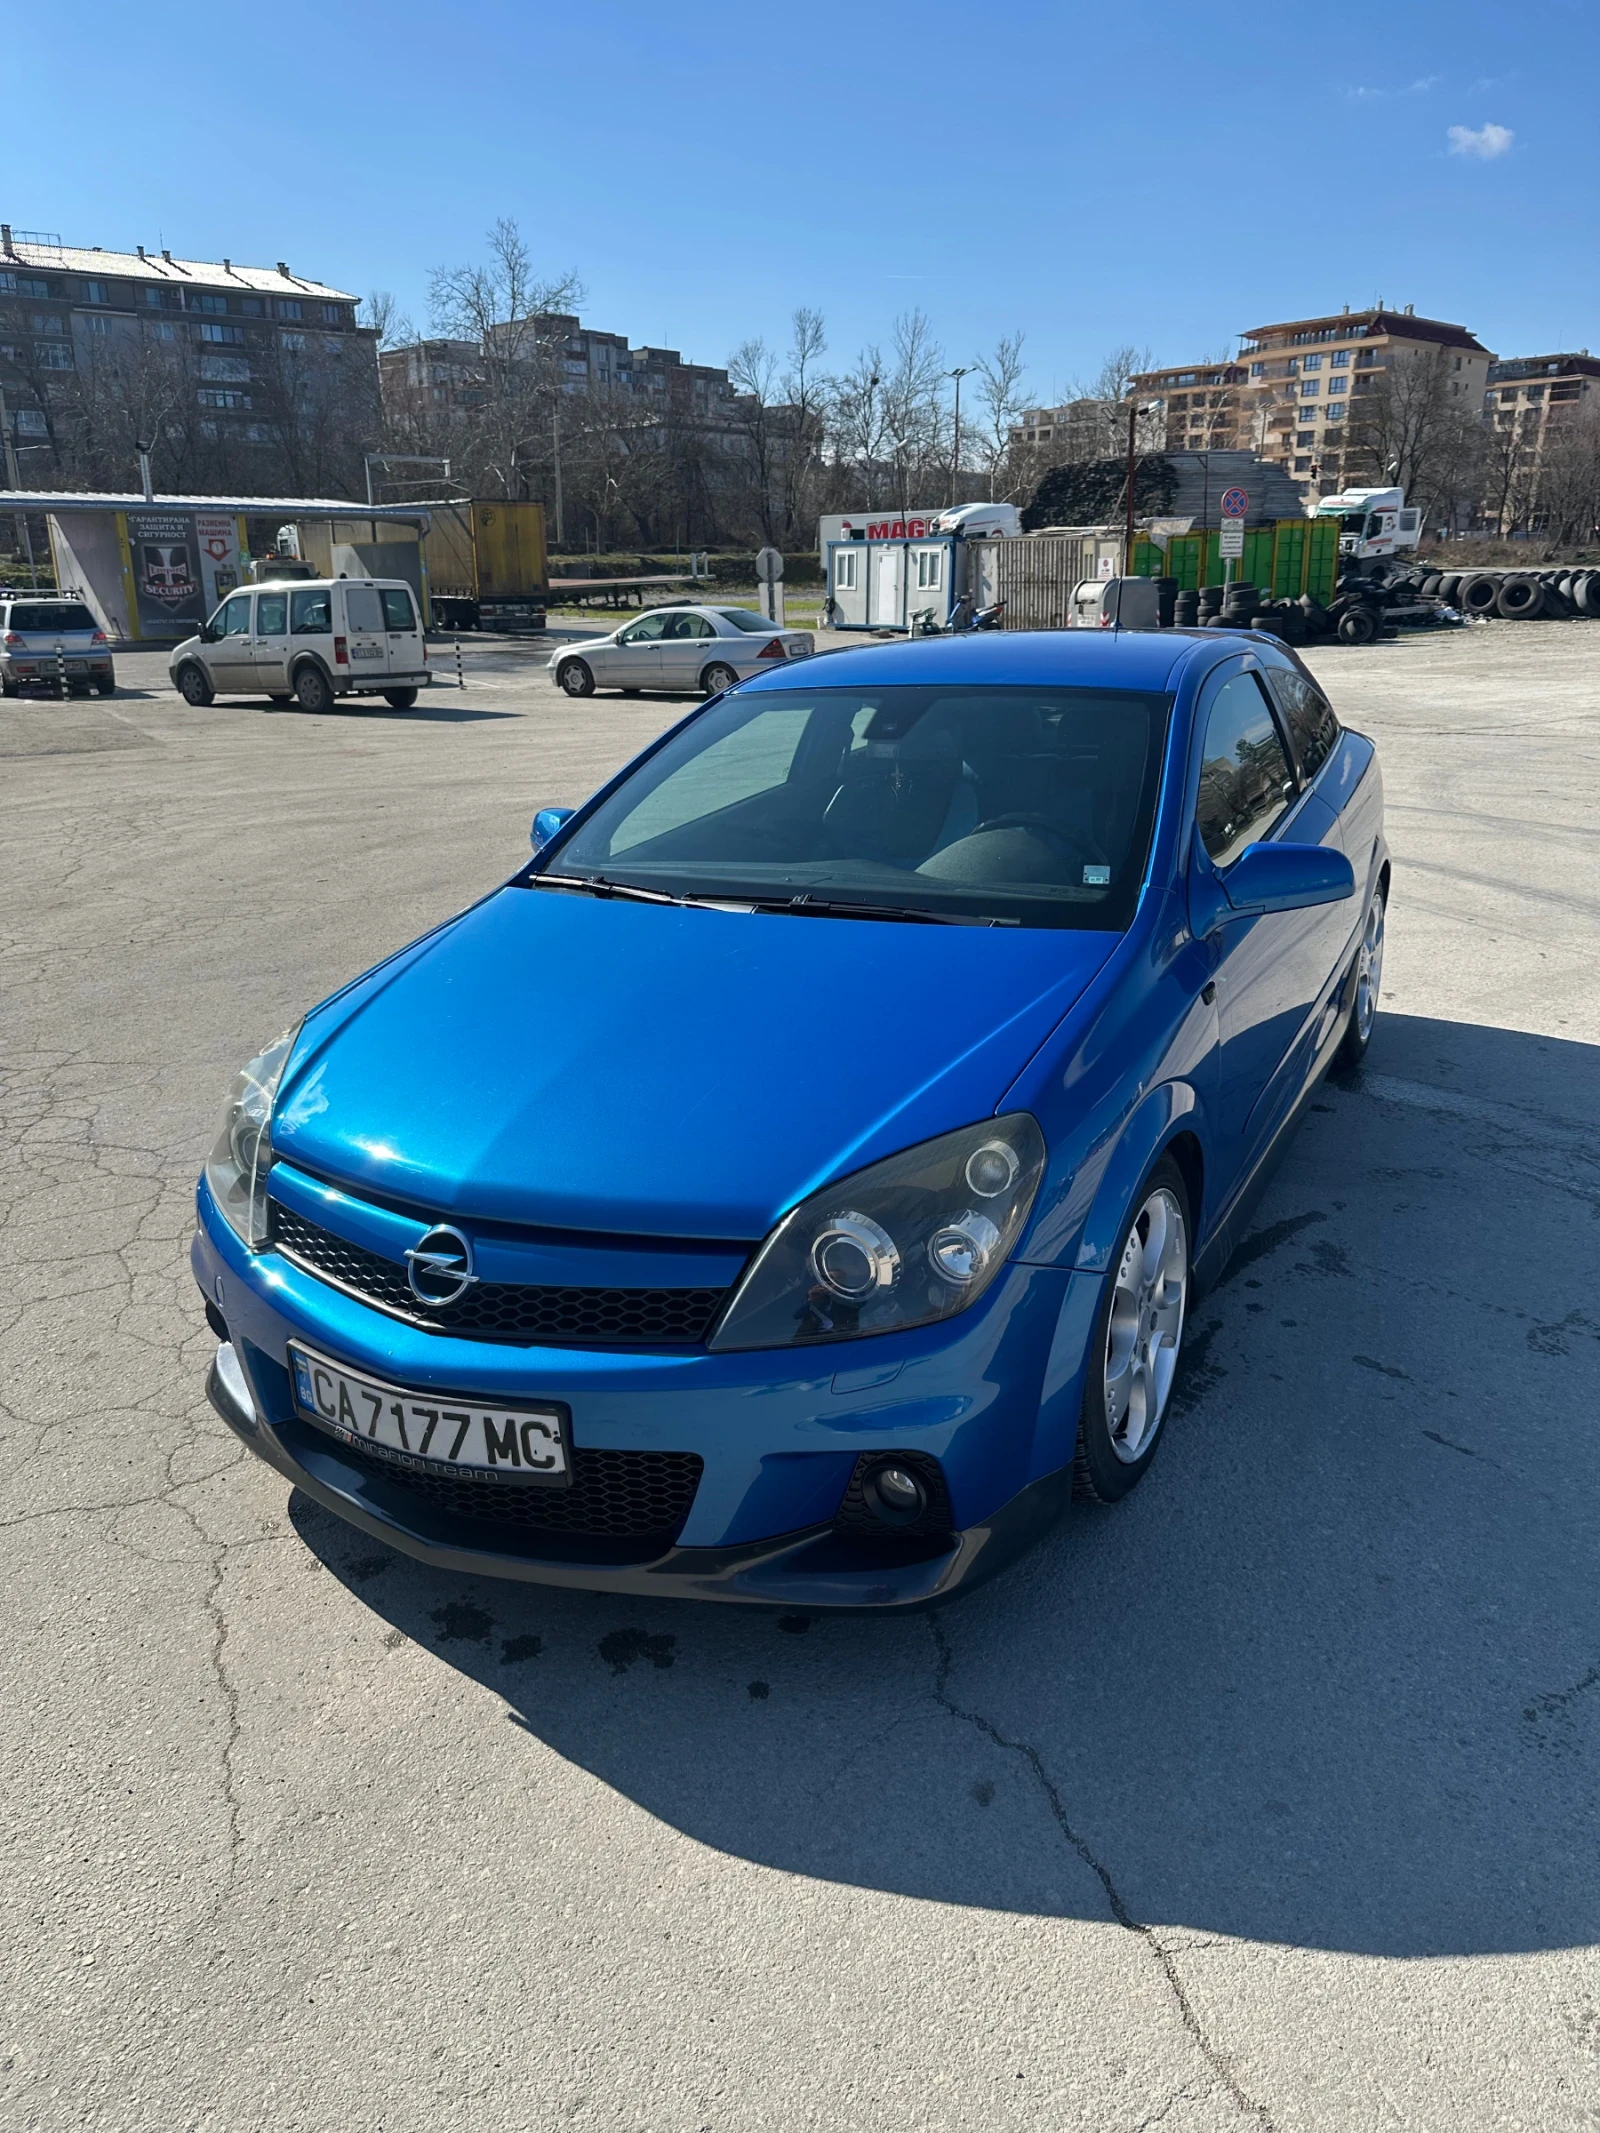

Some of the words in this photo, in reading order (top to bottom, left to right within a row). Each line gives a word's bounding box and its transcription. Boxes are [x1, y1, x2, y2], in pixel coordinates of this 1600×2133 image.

[197, 519, 232, 527] РАЗМЕННА
[198, 528, 233, 536] МАШИНА
[150, 566, 187, 576] Empire
[145, 583, 195, 595] SECURITY
[300, 1386, 313, 1404] BG
